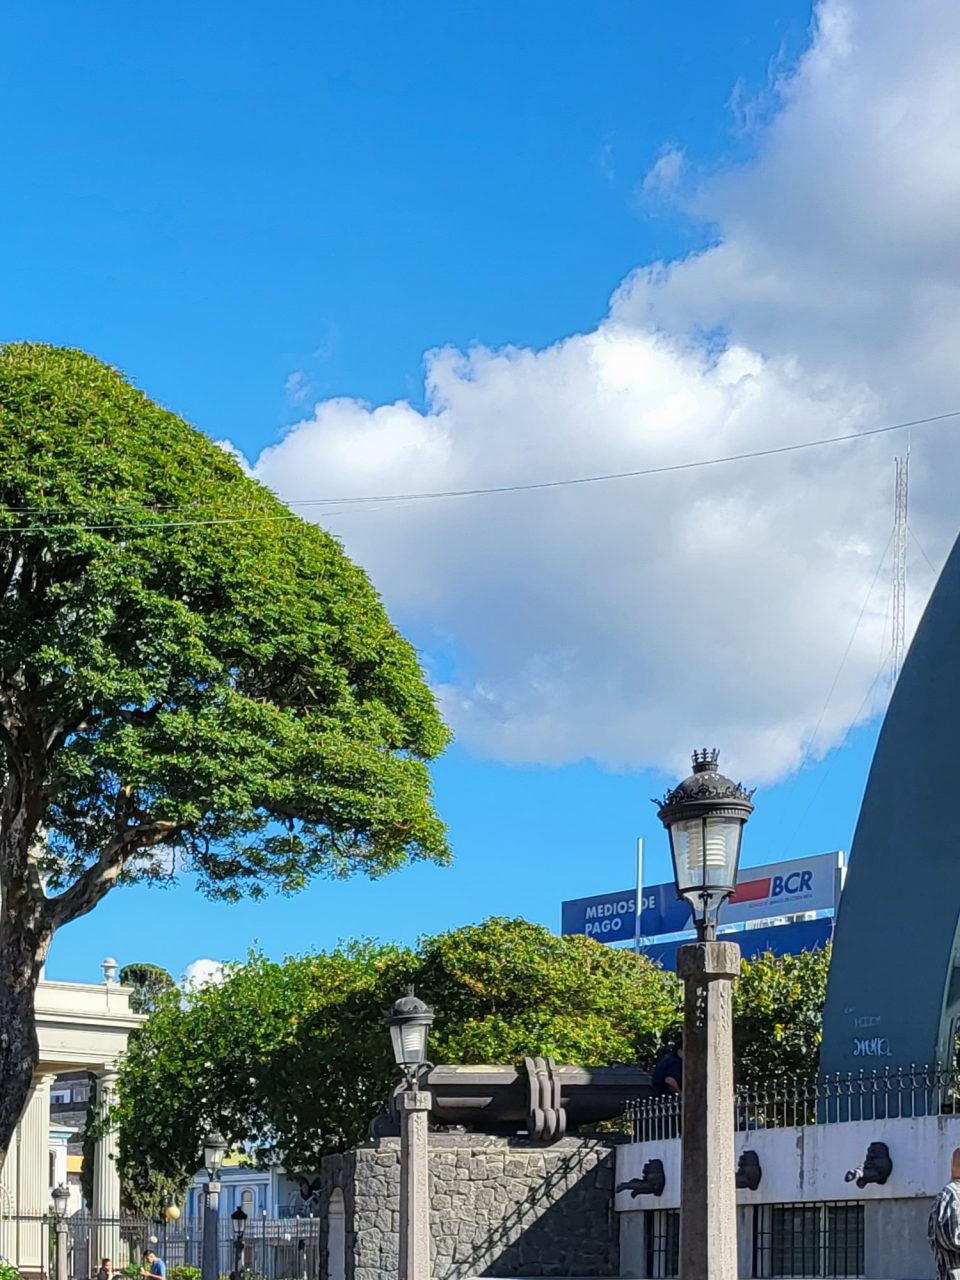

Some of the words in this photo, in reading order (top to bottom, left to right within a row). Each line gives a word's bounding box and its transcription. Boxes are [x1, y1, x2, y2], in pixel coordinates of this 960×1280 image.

[771, 870, 813, 897] BCR
[585, 899, 635, 919] MEDIOS
[585, 918, 622, 937] PAGO
